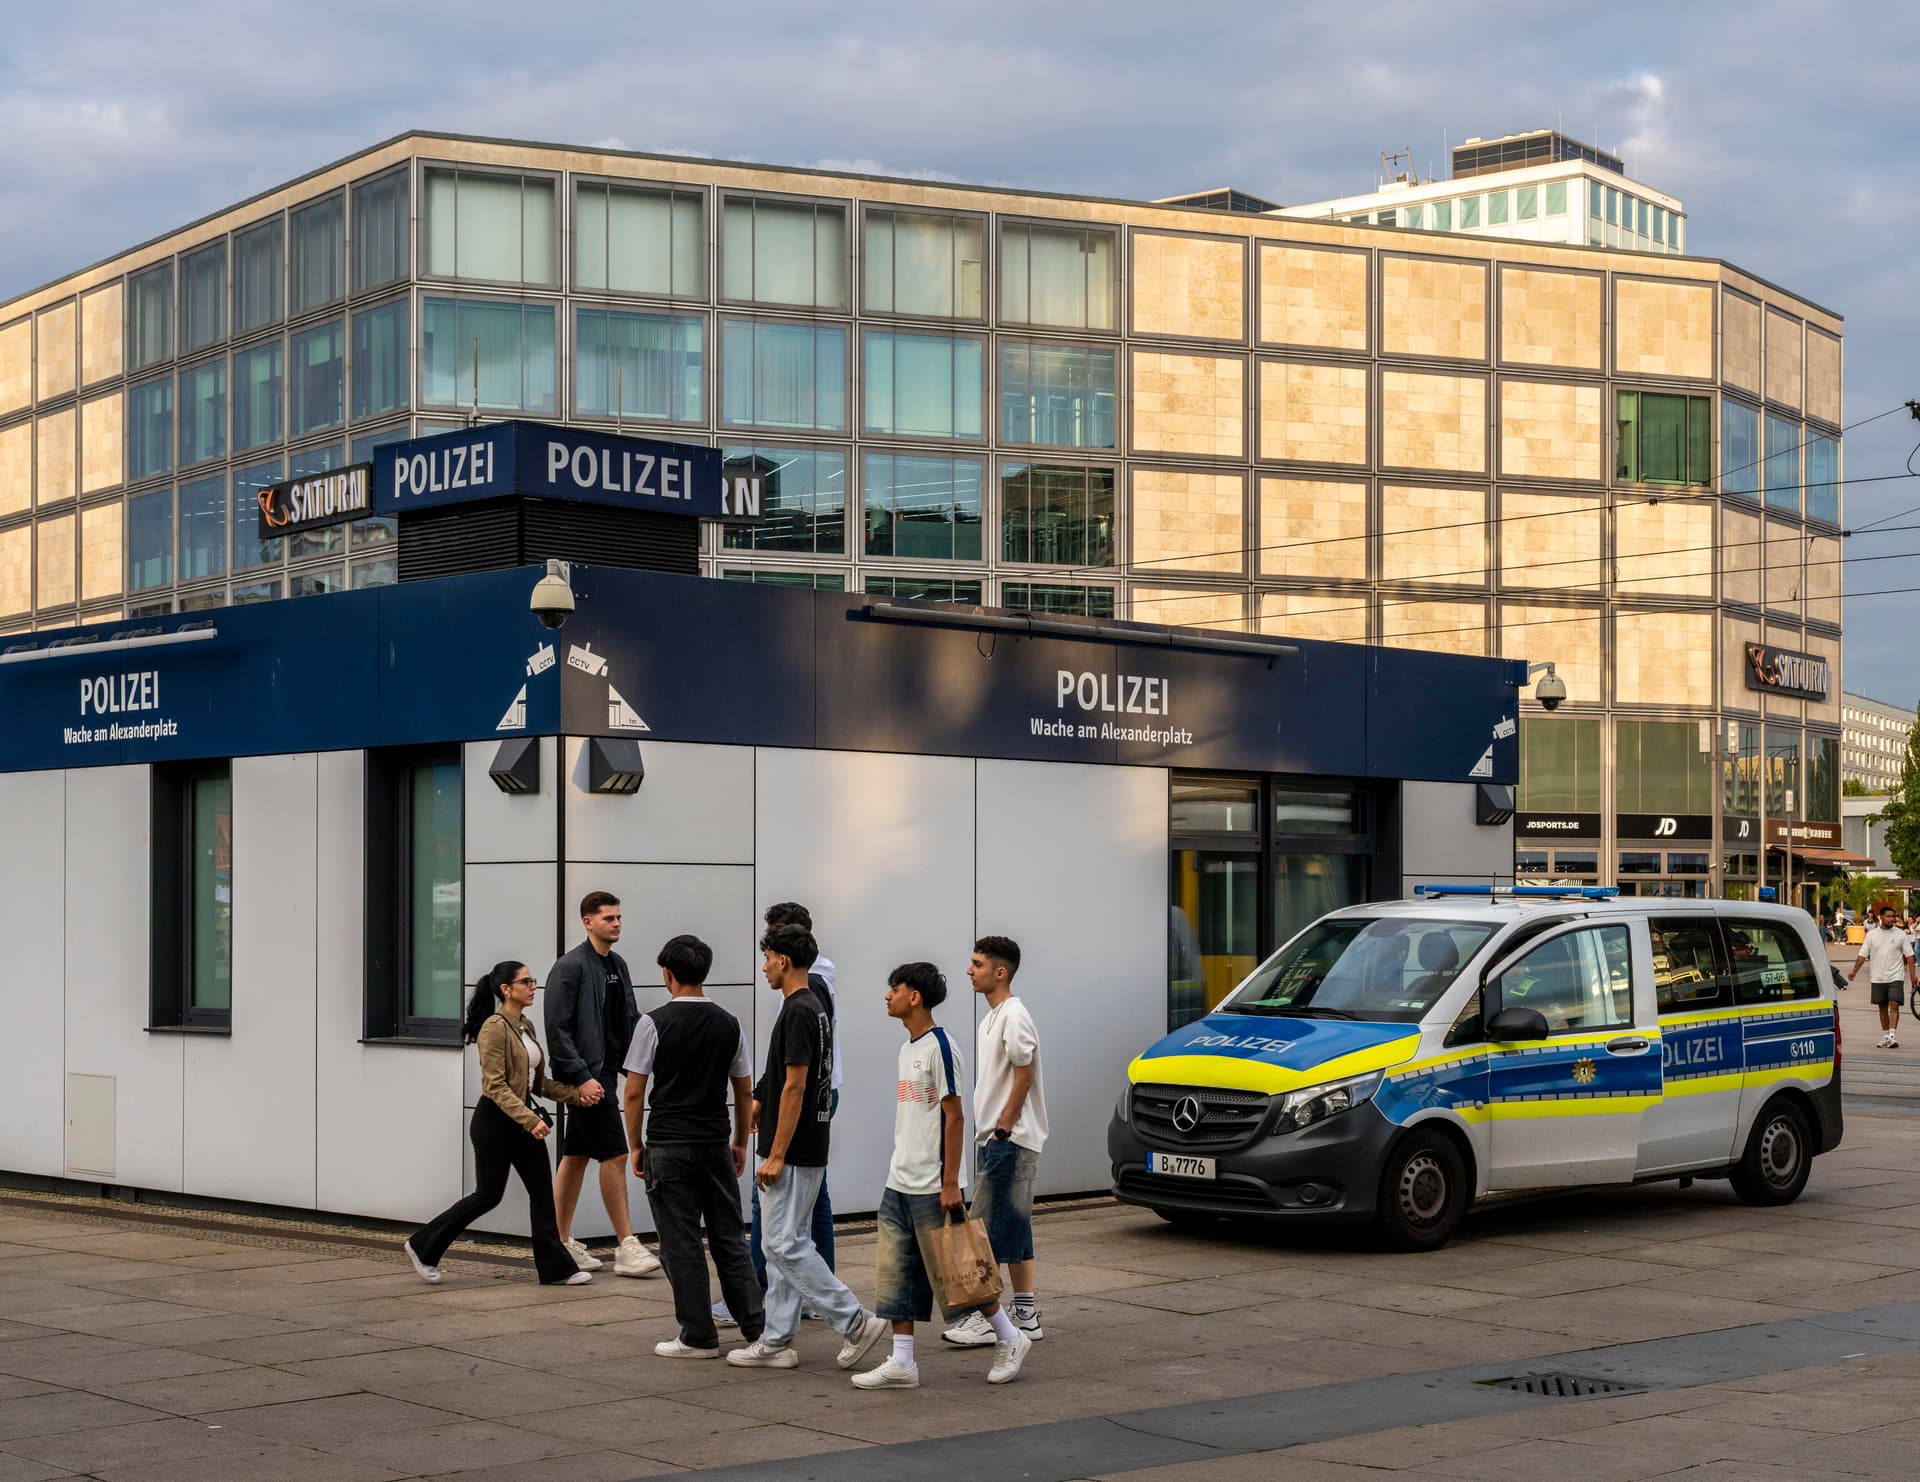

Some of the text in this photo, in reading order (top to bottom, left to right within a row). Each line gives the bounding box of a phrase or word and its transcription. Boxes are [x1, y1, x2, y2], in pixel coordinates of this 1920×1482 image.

[394, 441, 493, 498] POLIZEI
[547, 441, 692, 500] POLIZEI
[290, 469, 366, 524] SATURN
[539, 656, 554, 670] CCTV
[569, 656, 590, 670] CCTV
[1778, 653, 1827, 693] SATURN
[80, 670, 159, 716] POLIZEI
[1057, 670, 1168, 715] POLIZEI
[64, 718, 178, 744] Wache am Alexanderplatz
[1030, 717, 1192, 747] Wache am Alexanderplatz
[1526, 821, 1579, 830] JDSPORTS.DE
[1655, 817, 1677, 836] JD
[1739, 820, 1750, 838] JD
[1184, 1035, 1297, 1053] POLIZEI
[1662, 1036, 1724, 1068] OLIZEI
[1799, 1040, 1815, 1056] 110
[1161, 1156, 1206, 1176] B 7776
